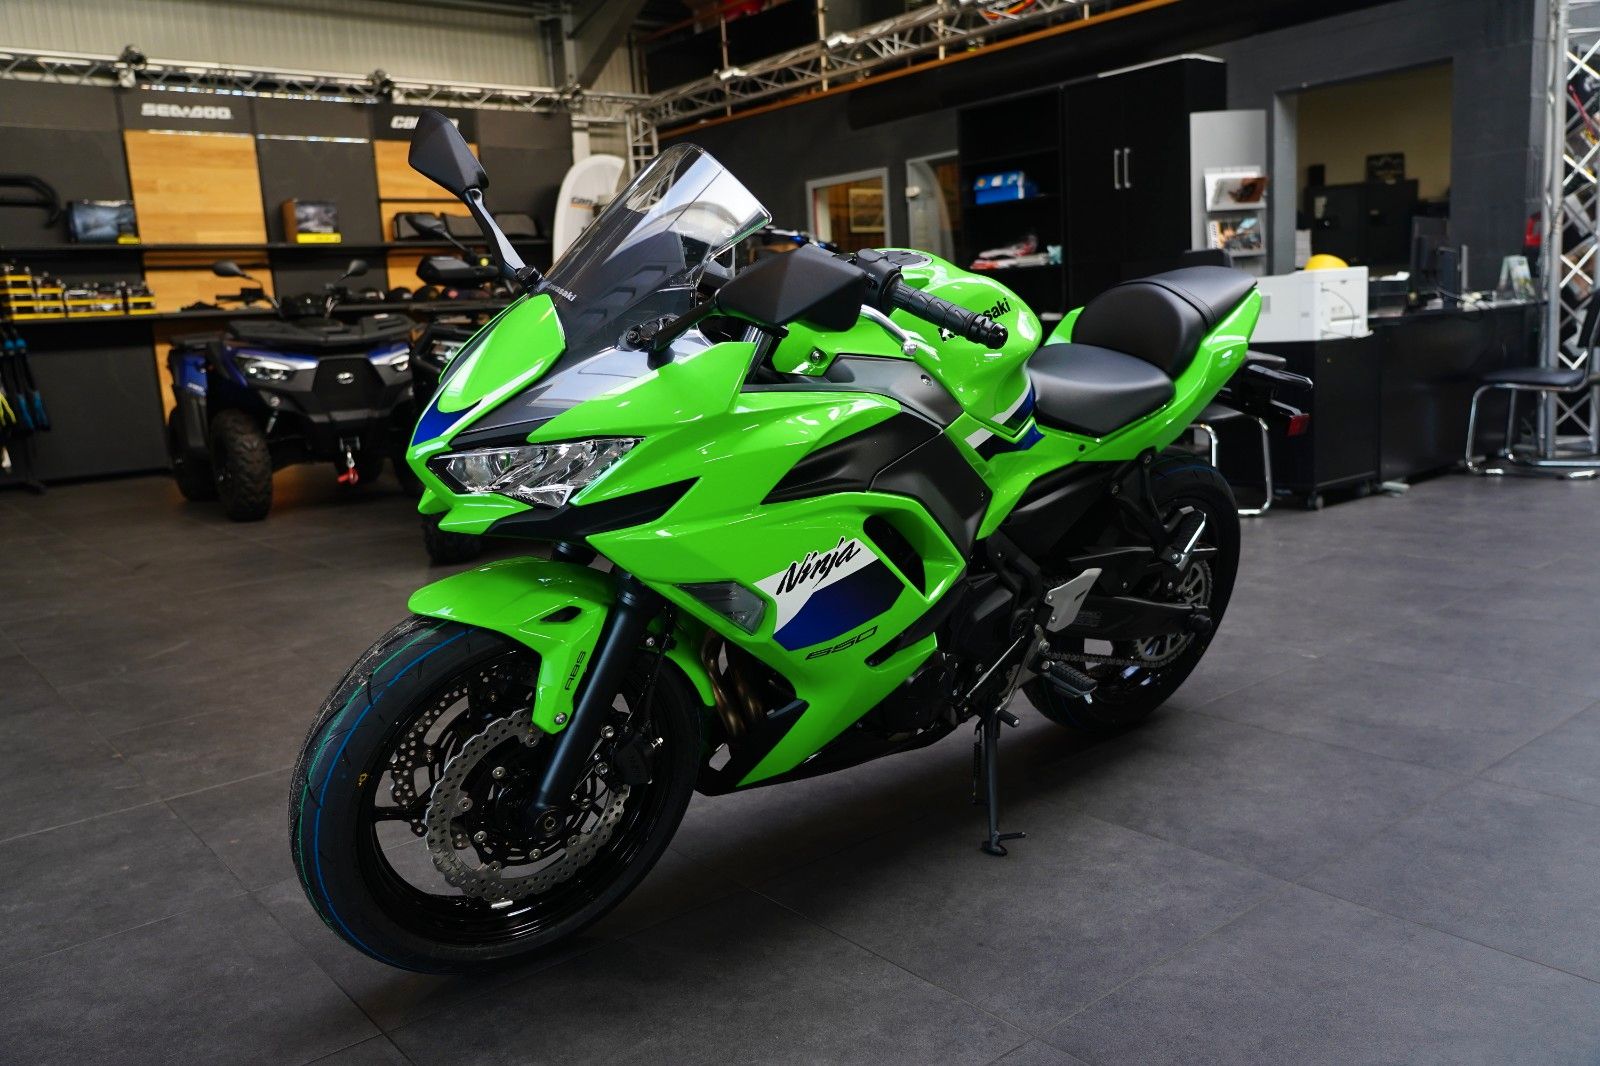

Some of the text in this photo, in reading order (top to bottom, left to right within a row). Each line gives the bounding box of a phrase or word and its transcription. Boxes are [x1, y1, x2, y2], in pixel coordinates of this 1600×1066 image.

[776, 537, 861, 595] Ninja
[805, 626, 878, 660] 650
[564, 650, 586, 690] ABS
